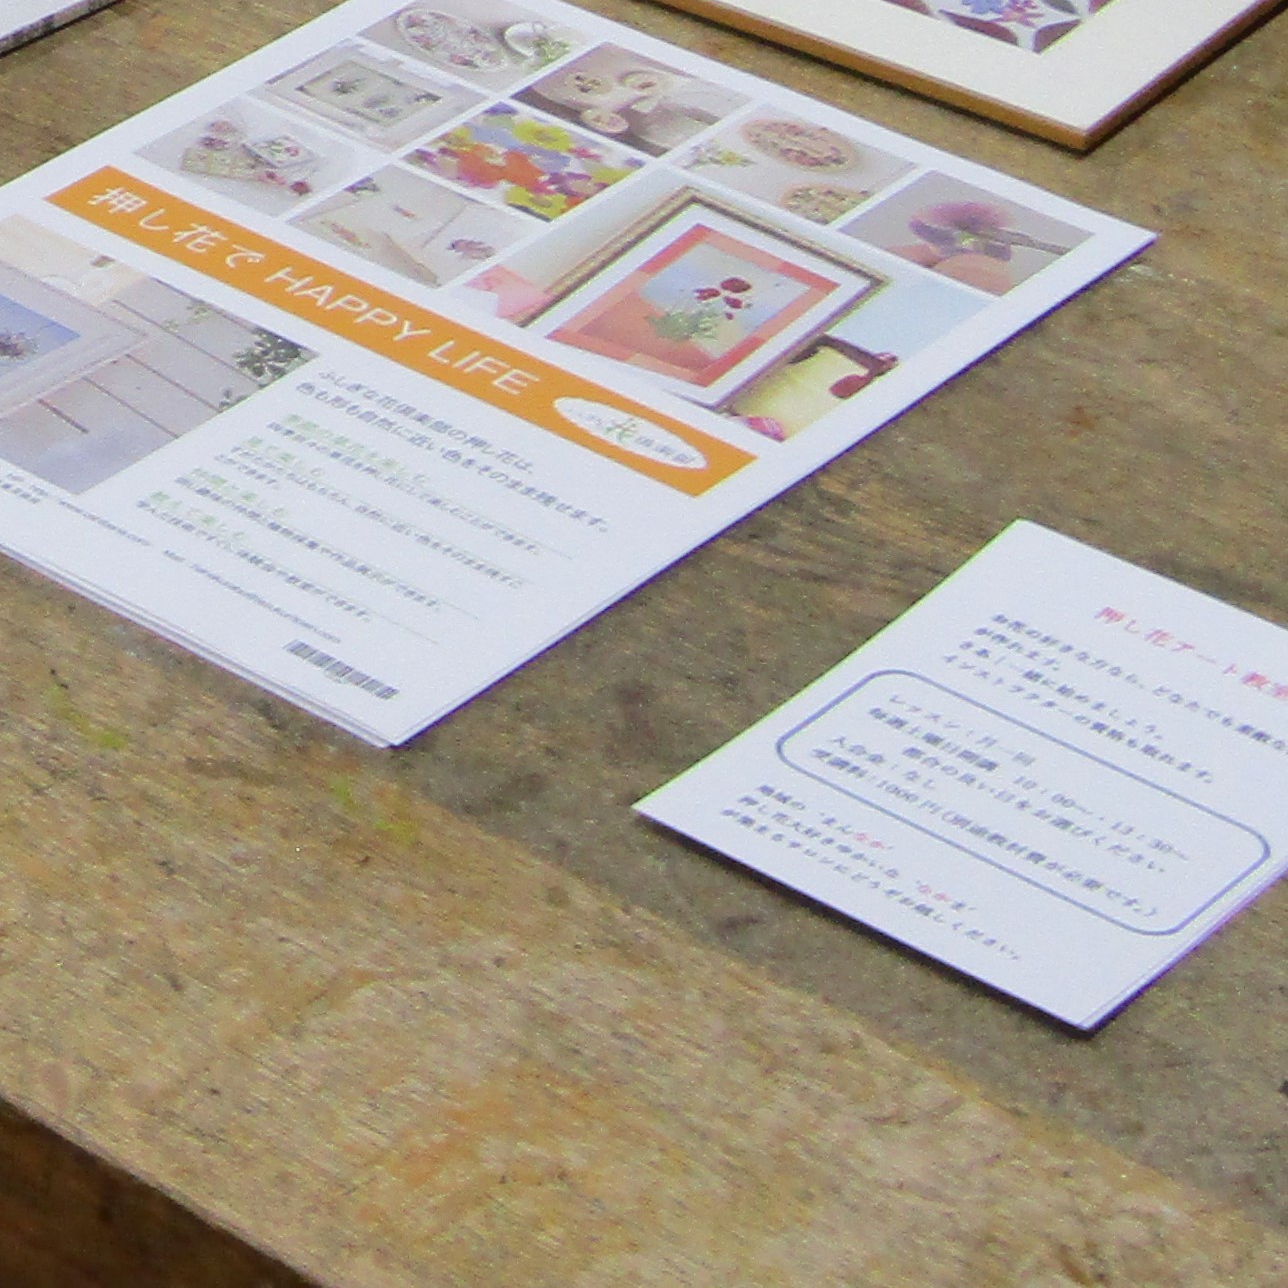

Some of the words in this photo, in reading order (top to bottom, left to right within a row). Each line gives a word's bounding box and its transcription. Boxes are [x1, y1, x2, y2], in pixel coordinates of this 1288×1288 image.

[87, 187, 266, 269] 押し花で
[263, 266, 432, 342] HAPPY
[426, 339, 541, 396] LIFE
